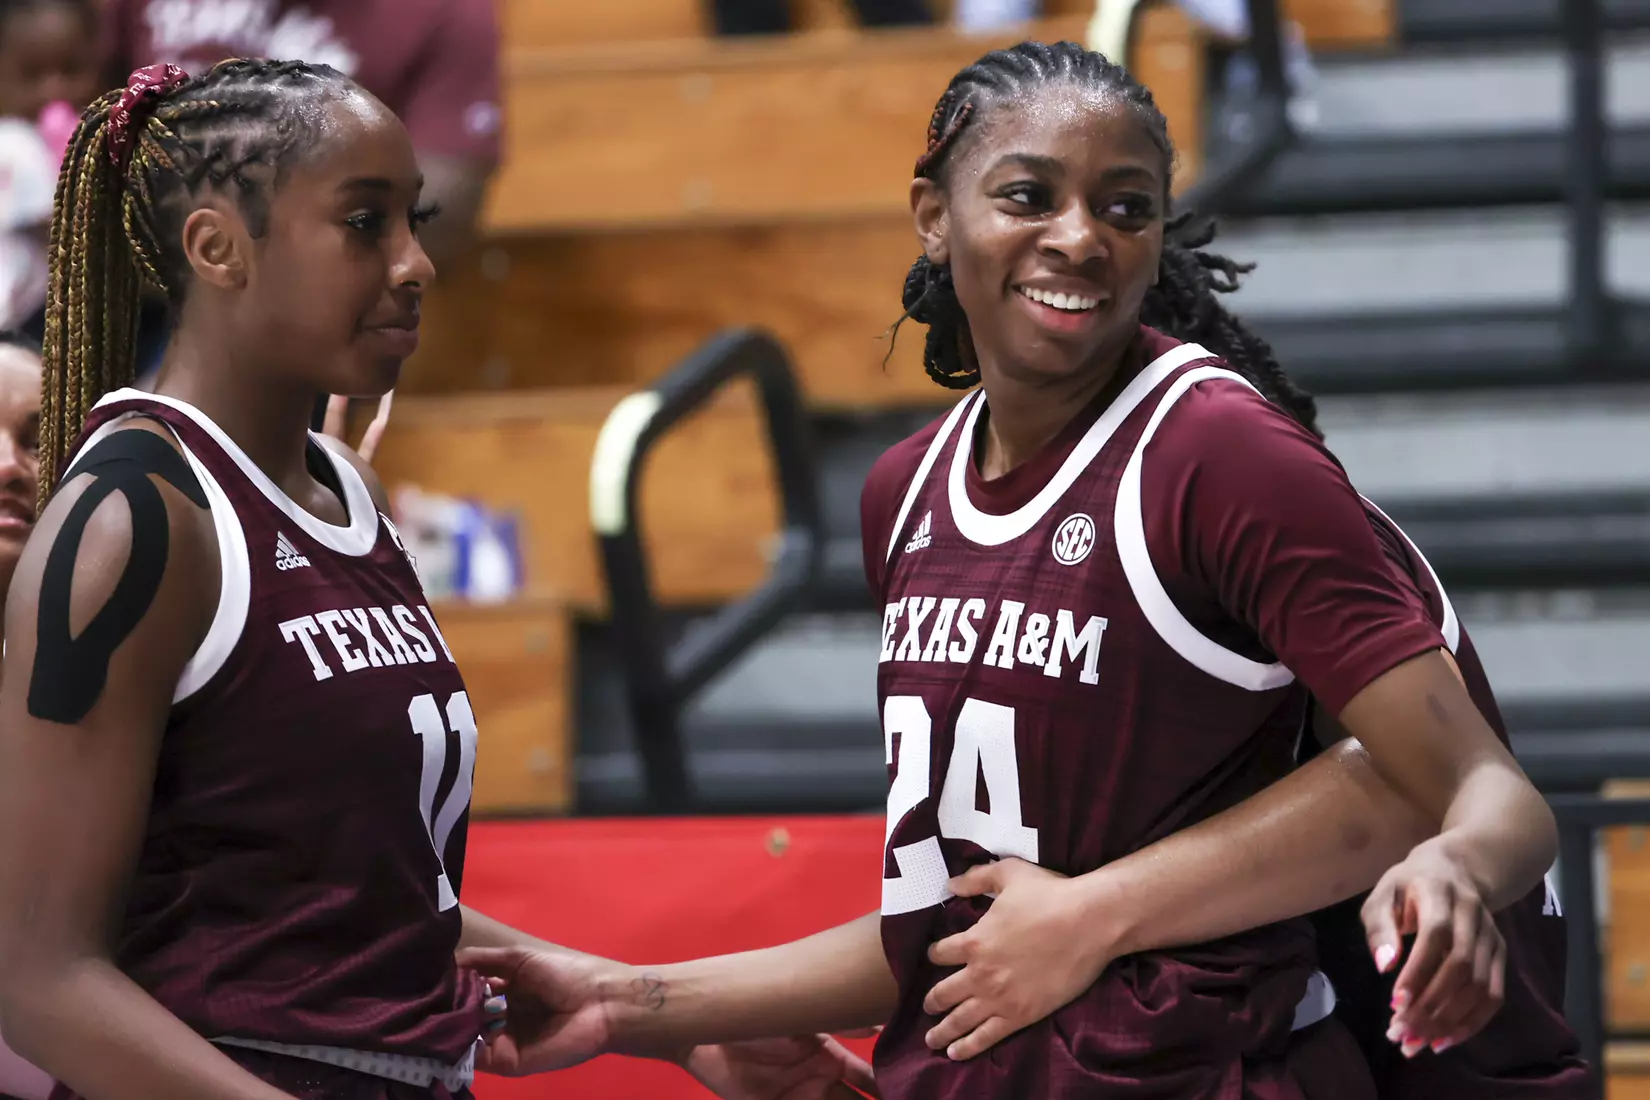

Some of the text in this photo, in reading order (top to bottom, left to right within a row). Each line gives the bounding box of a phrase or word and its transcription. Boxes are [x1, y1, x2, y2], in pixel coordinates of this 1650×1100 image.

[275, 554, 312, 571] adidas
[905, 535, 932, 553] adidas
[1056, 517, 1093, 561] SEC
[277, 604, 437, 682] TEXAS
[983, 599, 1109, 685] A&M
[407, 690, 478, 912] 11
[880, 695, 1039, 916] 24
